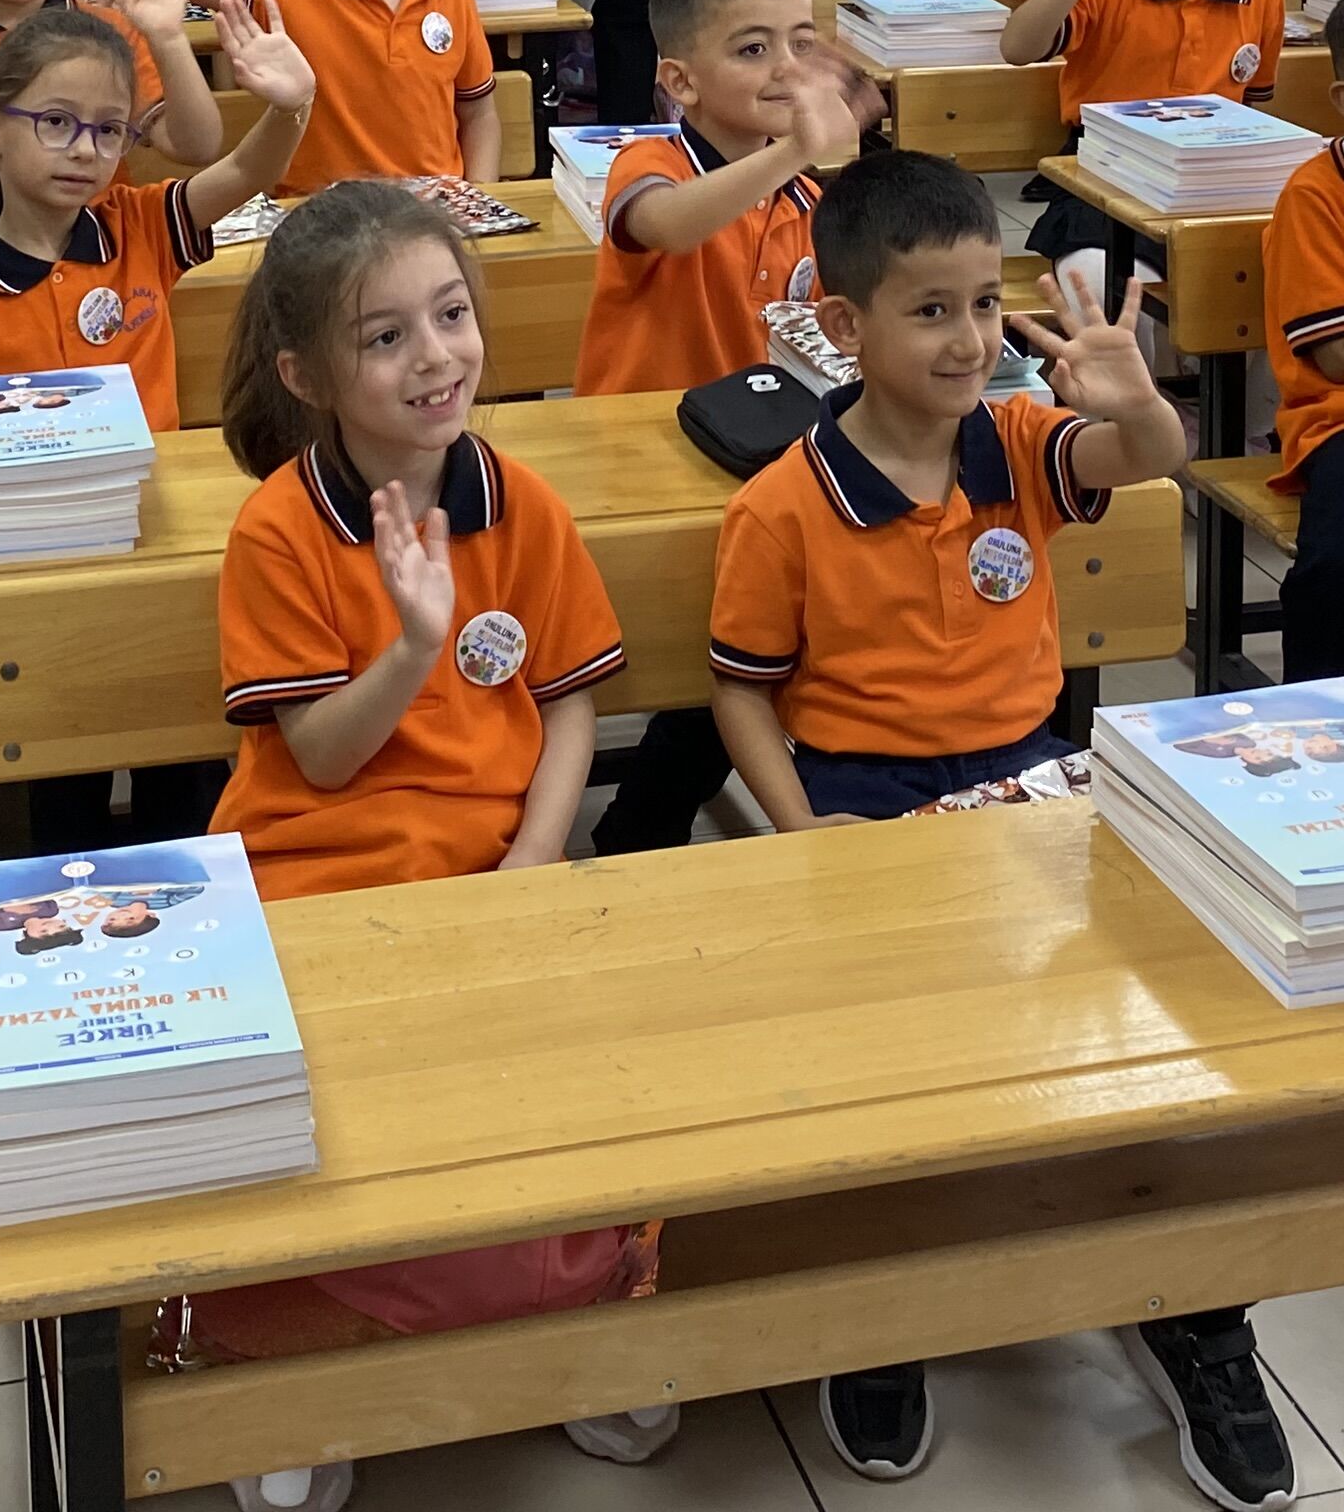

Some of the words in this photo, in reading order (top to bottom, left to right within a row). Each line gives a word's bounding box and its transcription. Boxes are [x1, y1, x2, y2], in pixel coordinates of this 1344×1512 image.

[987, 536, 1022, 556] OKULUNA
[484, 618, 517, 643] OKULUNA
[73, 983, 139, 1001] KİTABI
[185, 985, 229, 1003] İLK
[87, 993, 175, 1016] OKUMA
[78, 1014, 127, 1029] SINIF
[56, 1019, 173, 1048] TÜRKÇE
